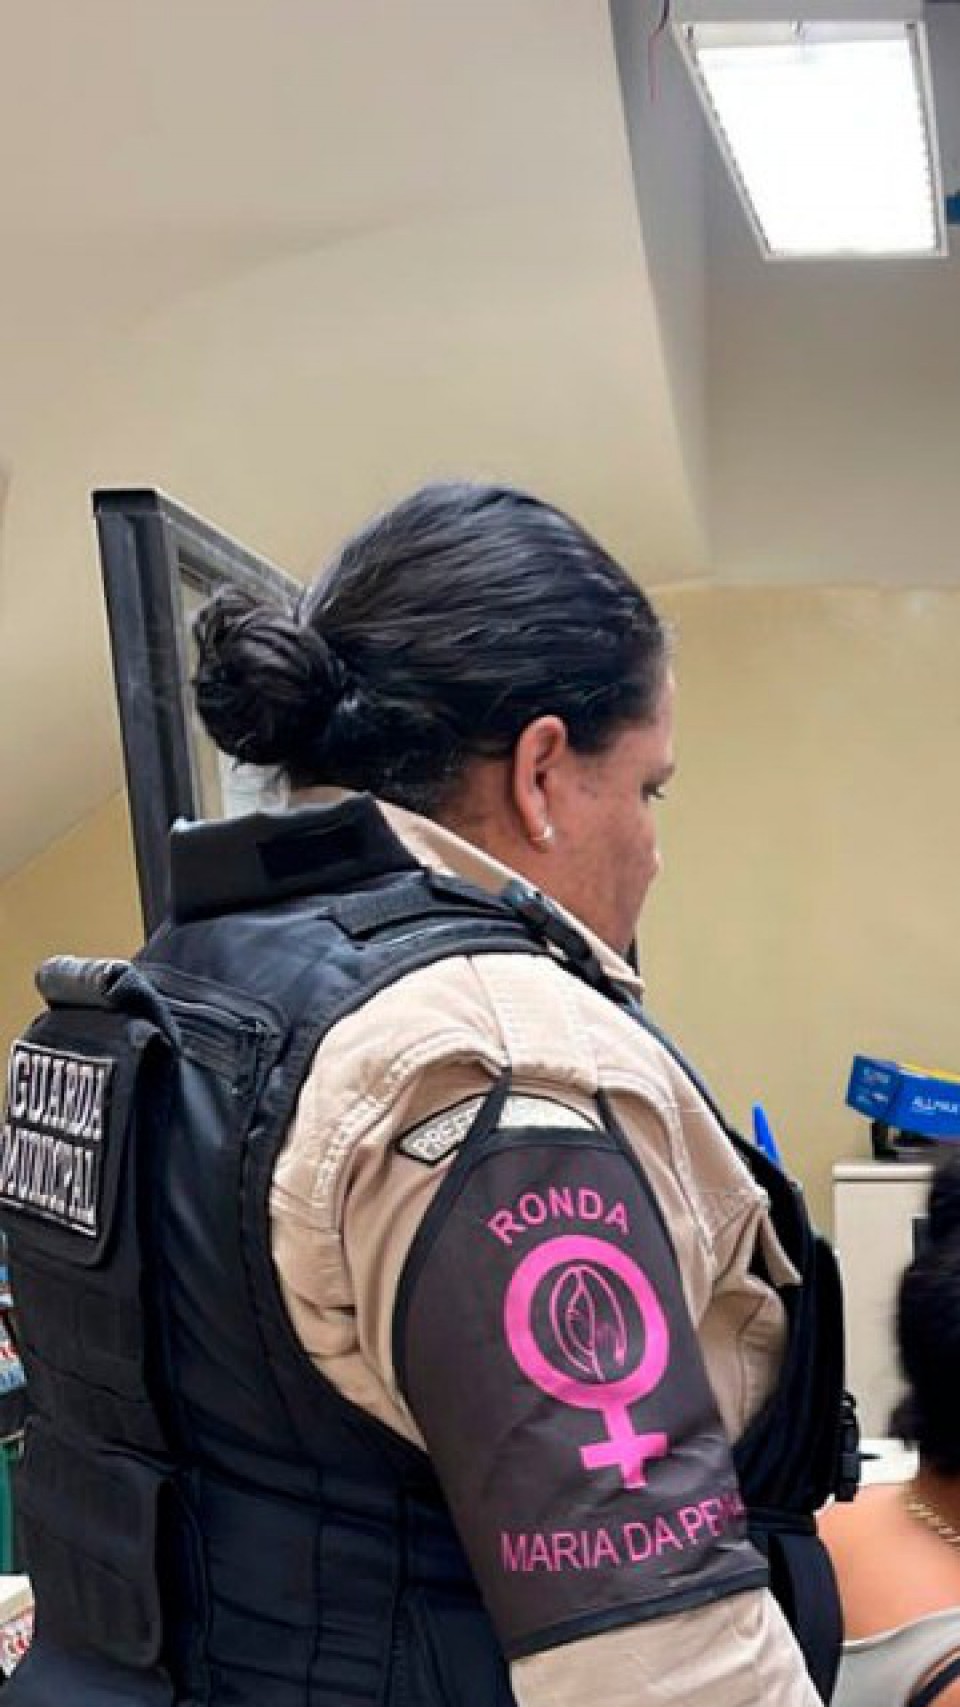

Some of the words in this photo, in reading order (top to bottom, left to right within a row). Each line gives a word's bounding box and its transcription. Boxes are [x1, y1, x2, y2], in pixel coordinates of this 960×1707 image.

[487, 1186, 630, 1246] RONDA
[501, 1526, 621, 1572] MARIA
[623, 1516, 684, 1562] DA
